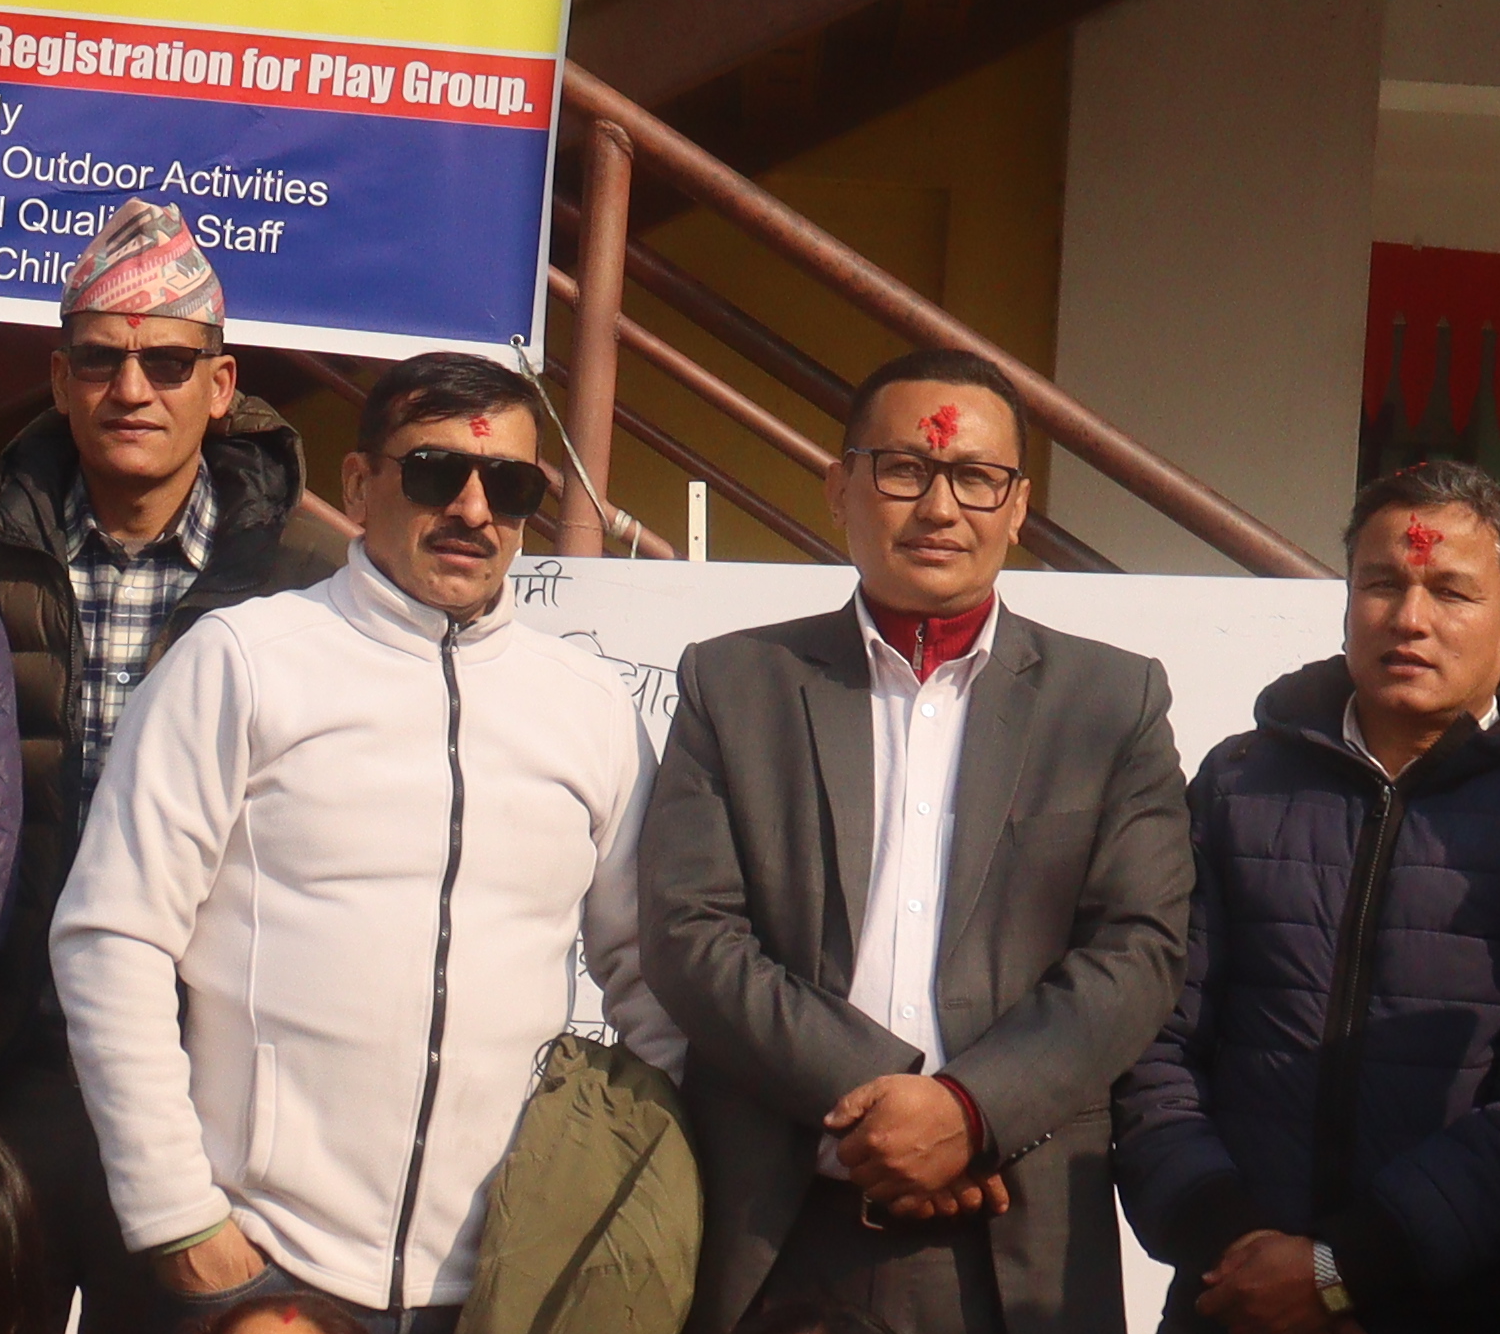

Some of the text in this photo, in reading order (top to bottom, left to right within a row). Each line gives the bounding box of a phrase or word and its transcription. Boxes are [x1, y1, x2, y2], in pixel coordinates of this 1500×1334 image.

[241, 47, 301, 92] for
[307, 53, 396, 104] Play
[402, 60, 533, 116] Group.
[2, 145, 155, 190] Outdoor
[160, 160, 328, 207] Activities
[18, 197, 115, 237] Quali
[195, 214, 285, 254] Staff
